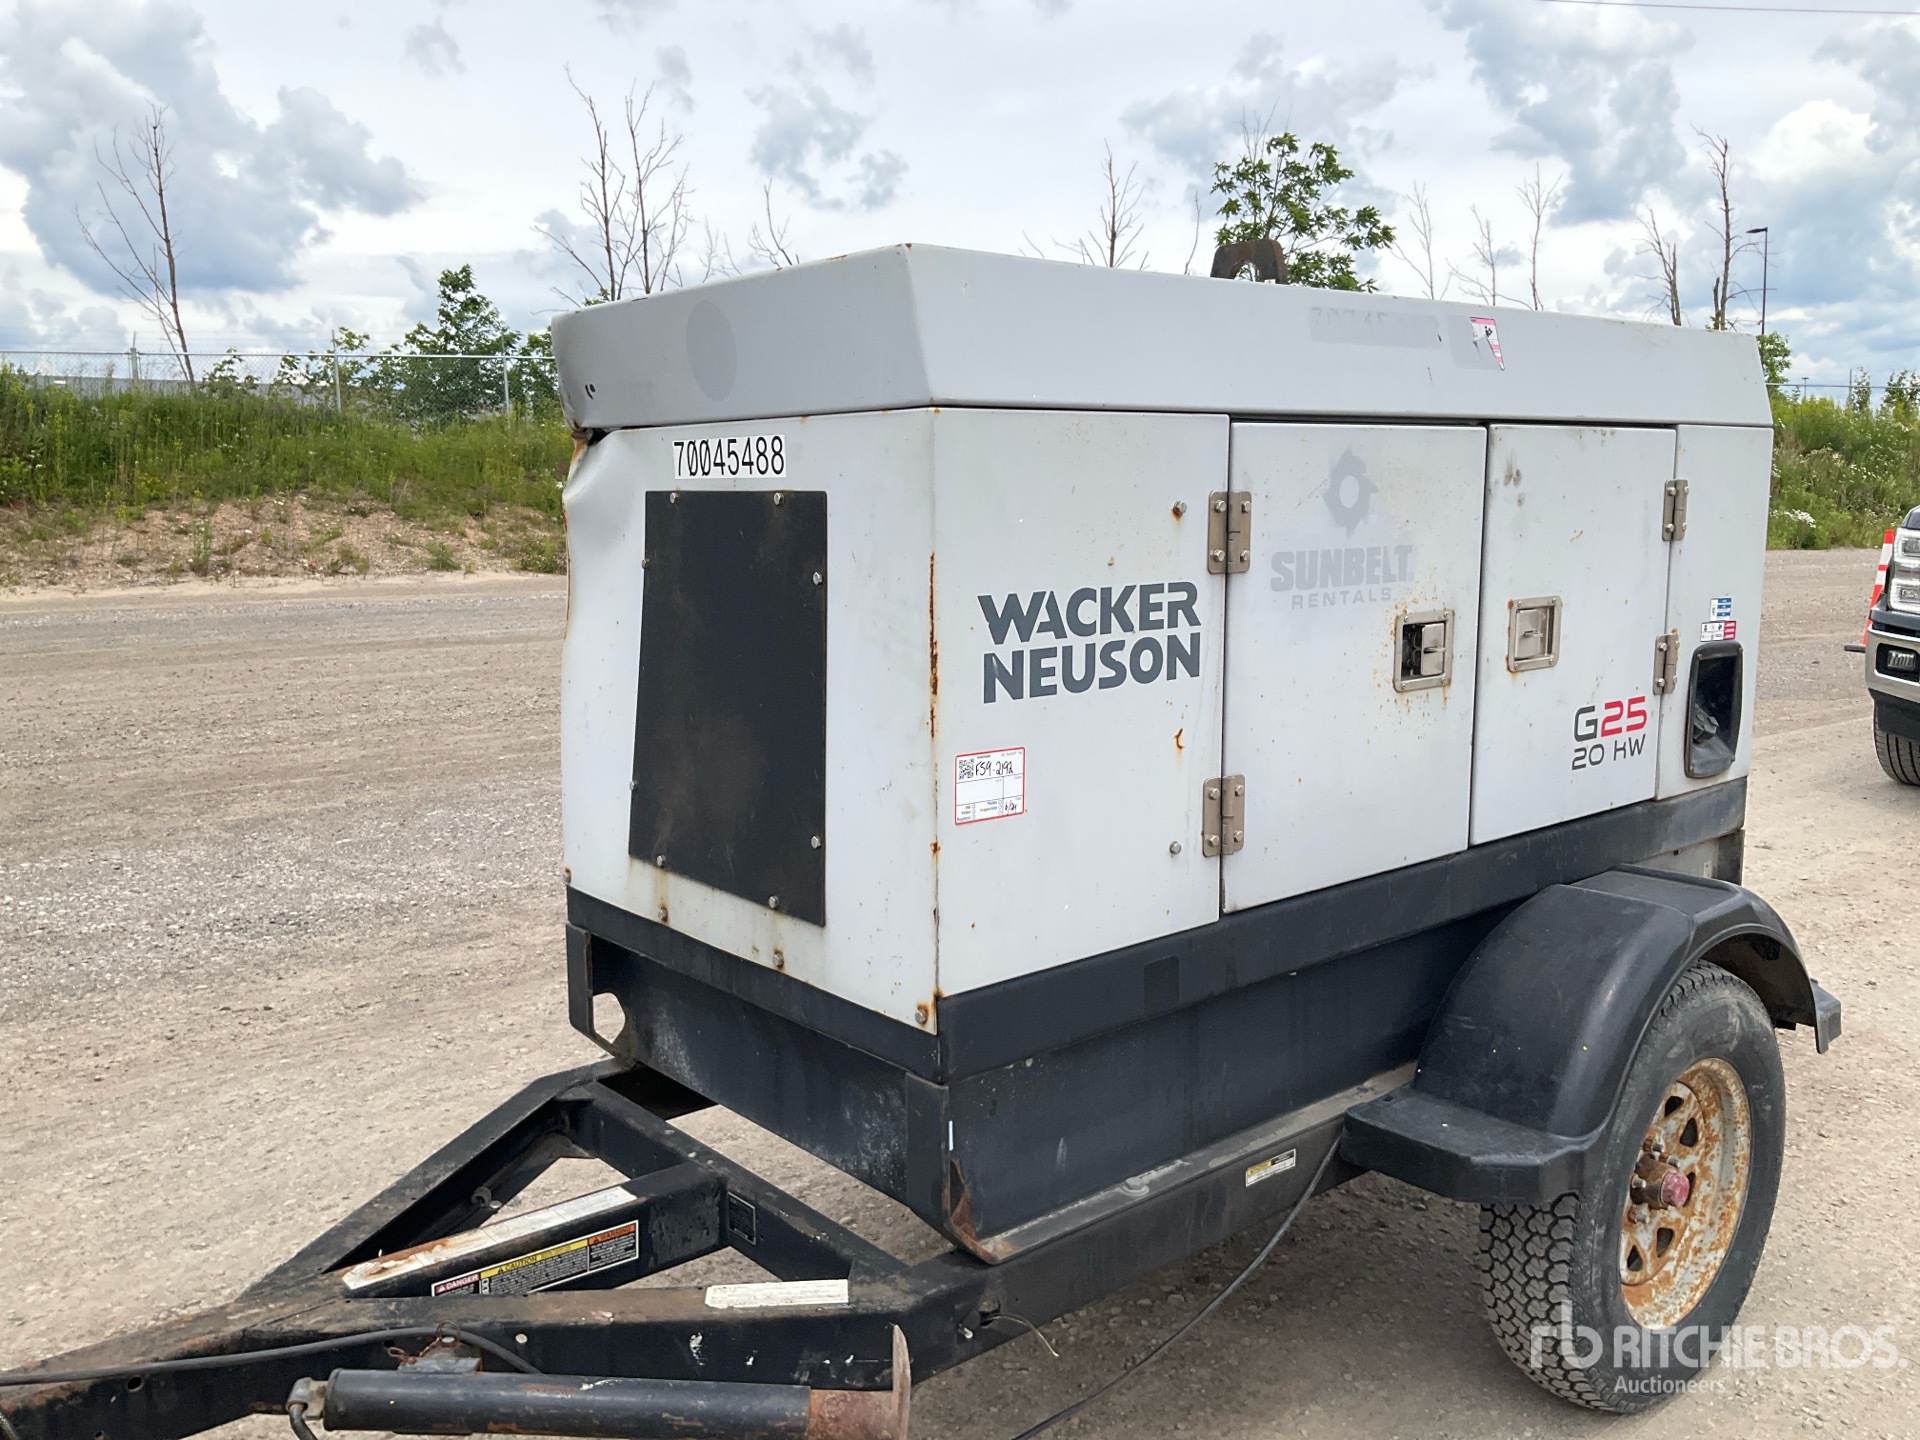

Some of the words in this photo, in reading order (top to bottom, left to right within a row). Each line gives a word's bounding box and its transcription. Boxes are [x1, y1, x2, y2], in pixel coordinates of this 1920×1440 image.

[674, 436, 785, 476] 70045488
[1270, 544, 1413, 591] SUNBELT
[977, 581, 1201, 645] WACKER
[1291, 587, 1392, 610] RENTALS
[983, 632, 1201, 704] NEUSON
[1573, 695, 1648, 742] G25
[1571, 743, 1605, 770] 20
[599, 1225, 633, 1241] WARNING
[505, 1255, 538, 1272] CAUTION
[445, 1273, 479, 1291] DANGER
